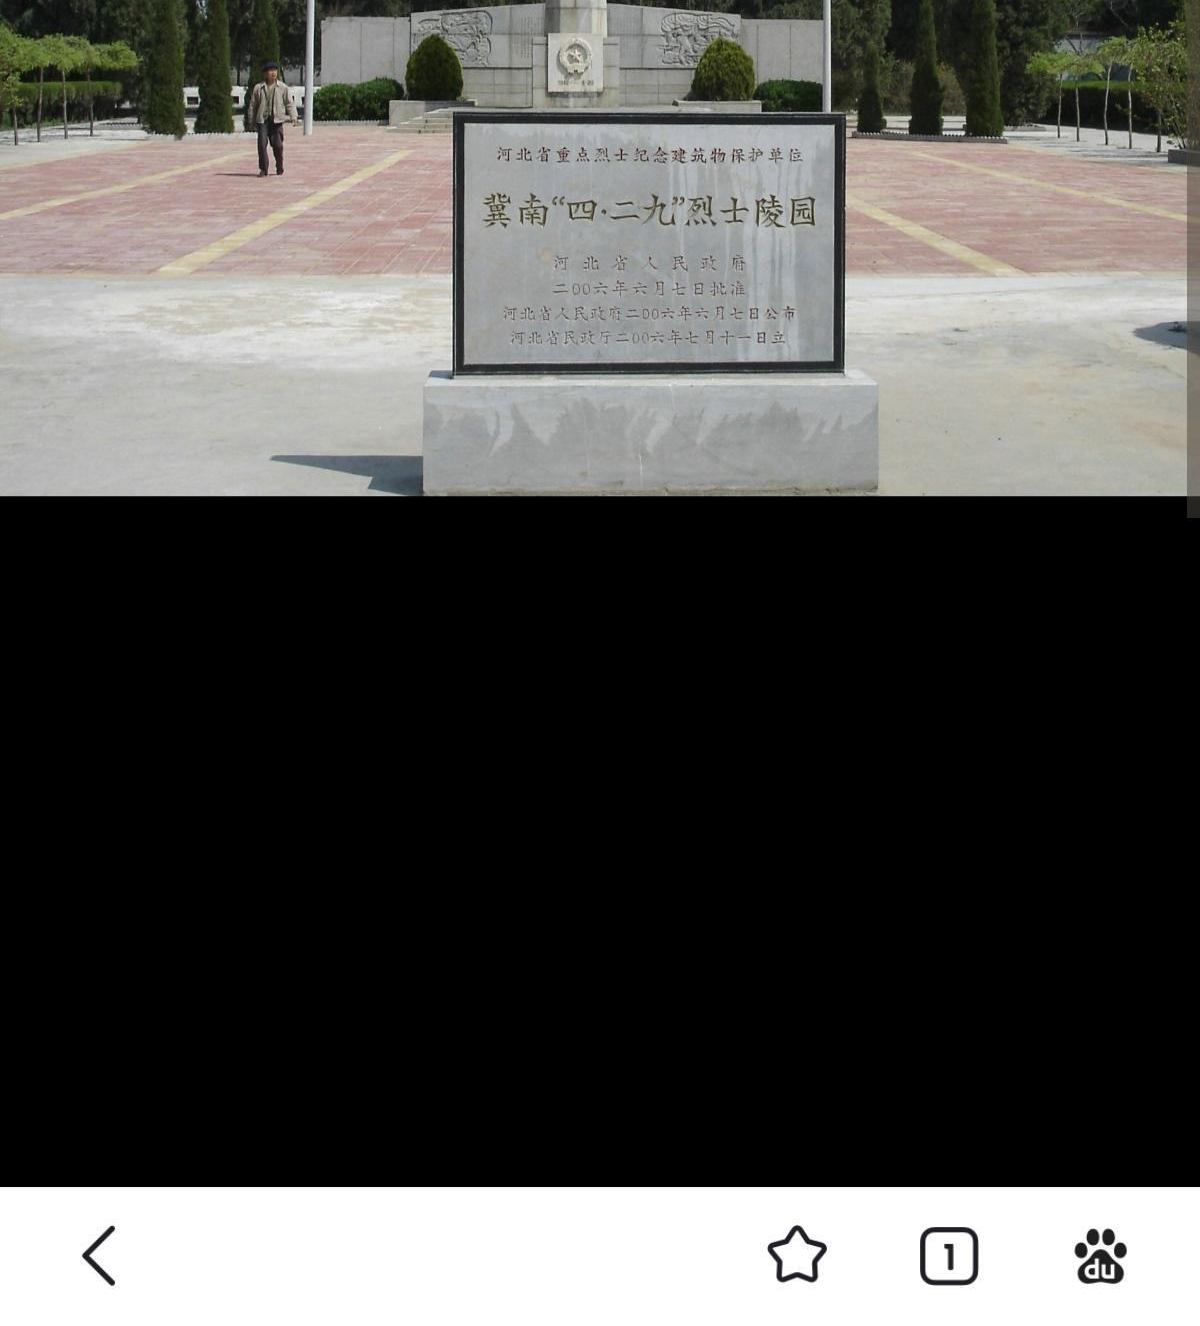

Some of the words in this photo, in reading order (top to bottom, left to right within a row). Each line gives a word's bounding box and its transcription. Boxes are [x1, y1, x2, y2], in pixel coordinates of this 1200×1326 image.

[496, 146, 805, 165] 河北省重点烈士纪念建筑物保护单位
[943, 1243, 955, 1271] 1
[1084, 1258, 1116, 1280] du
